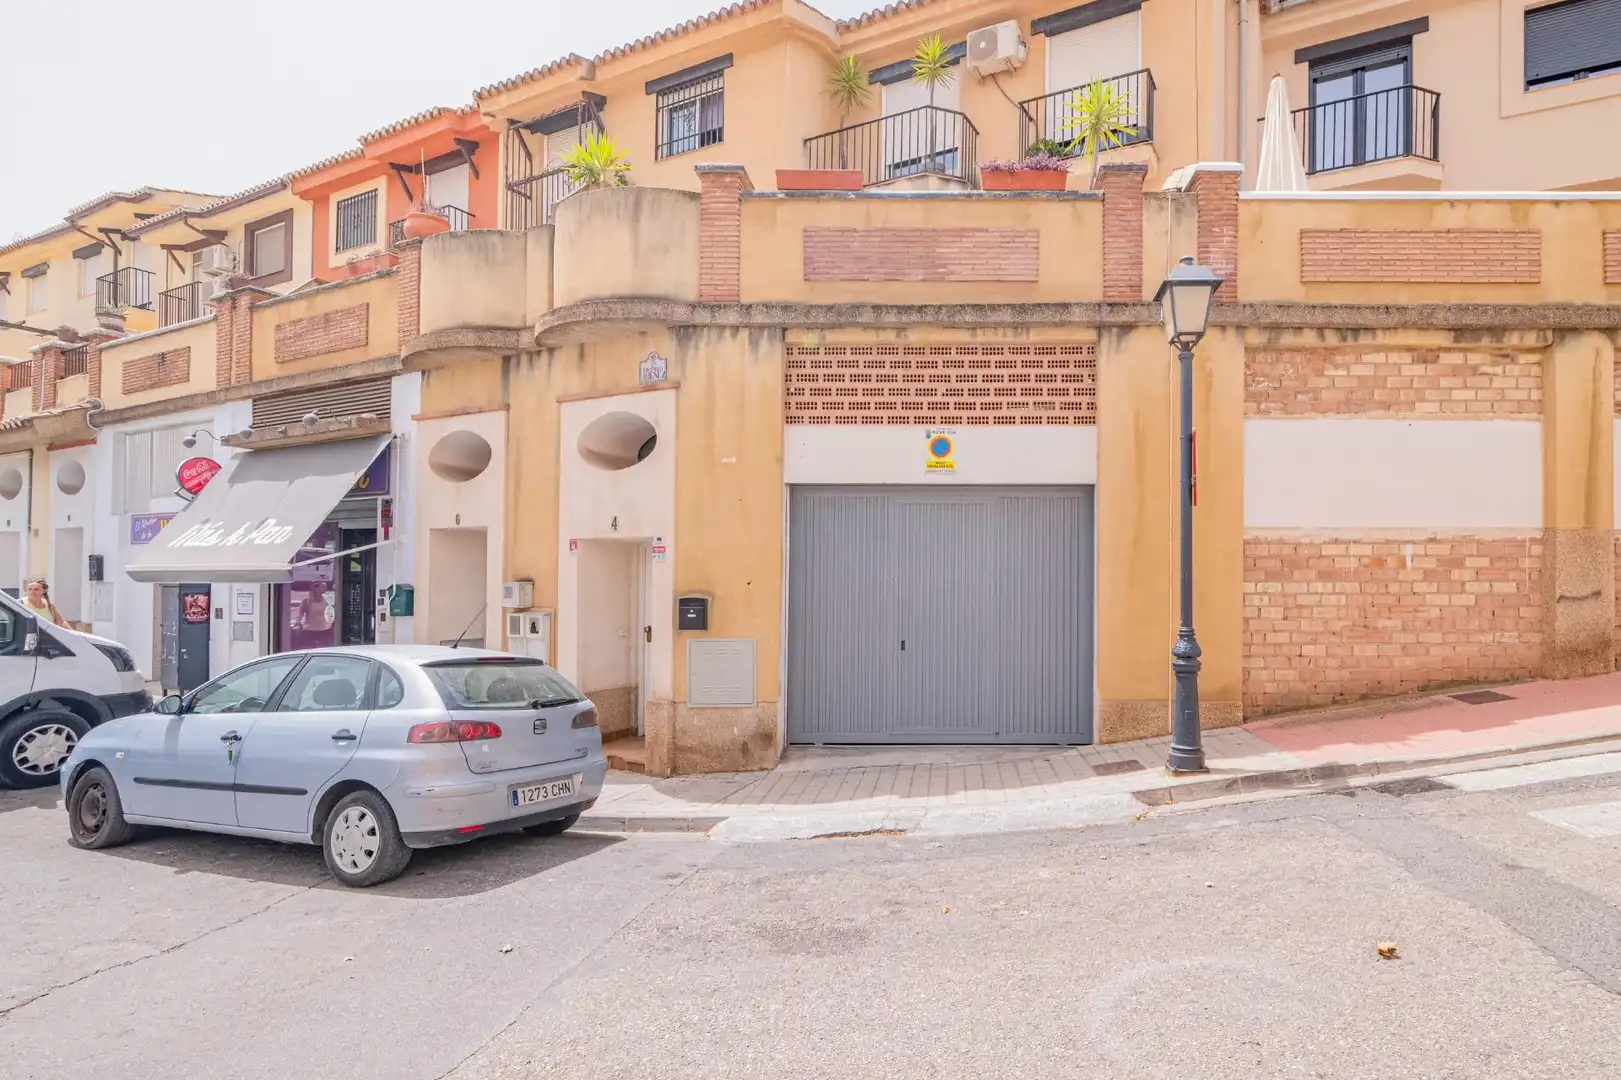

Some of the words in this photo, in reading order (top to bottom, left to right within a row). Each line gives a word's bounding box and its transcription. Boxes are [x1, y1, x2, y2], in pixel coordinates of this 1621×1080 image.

[455, 514, 461, 526] 6
[610, 515, 618, 531] 4
[521, 785, 549, 803] 1273
[551, 781, 571, 797] CHN
